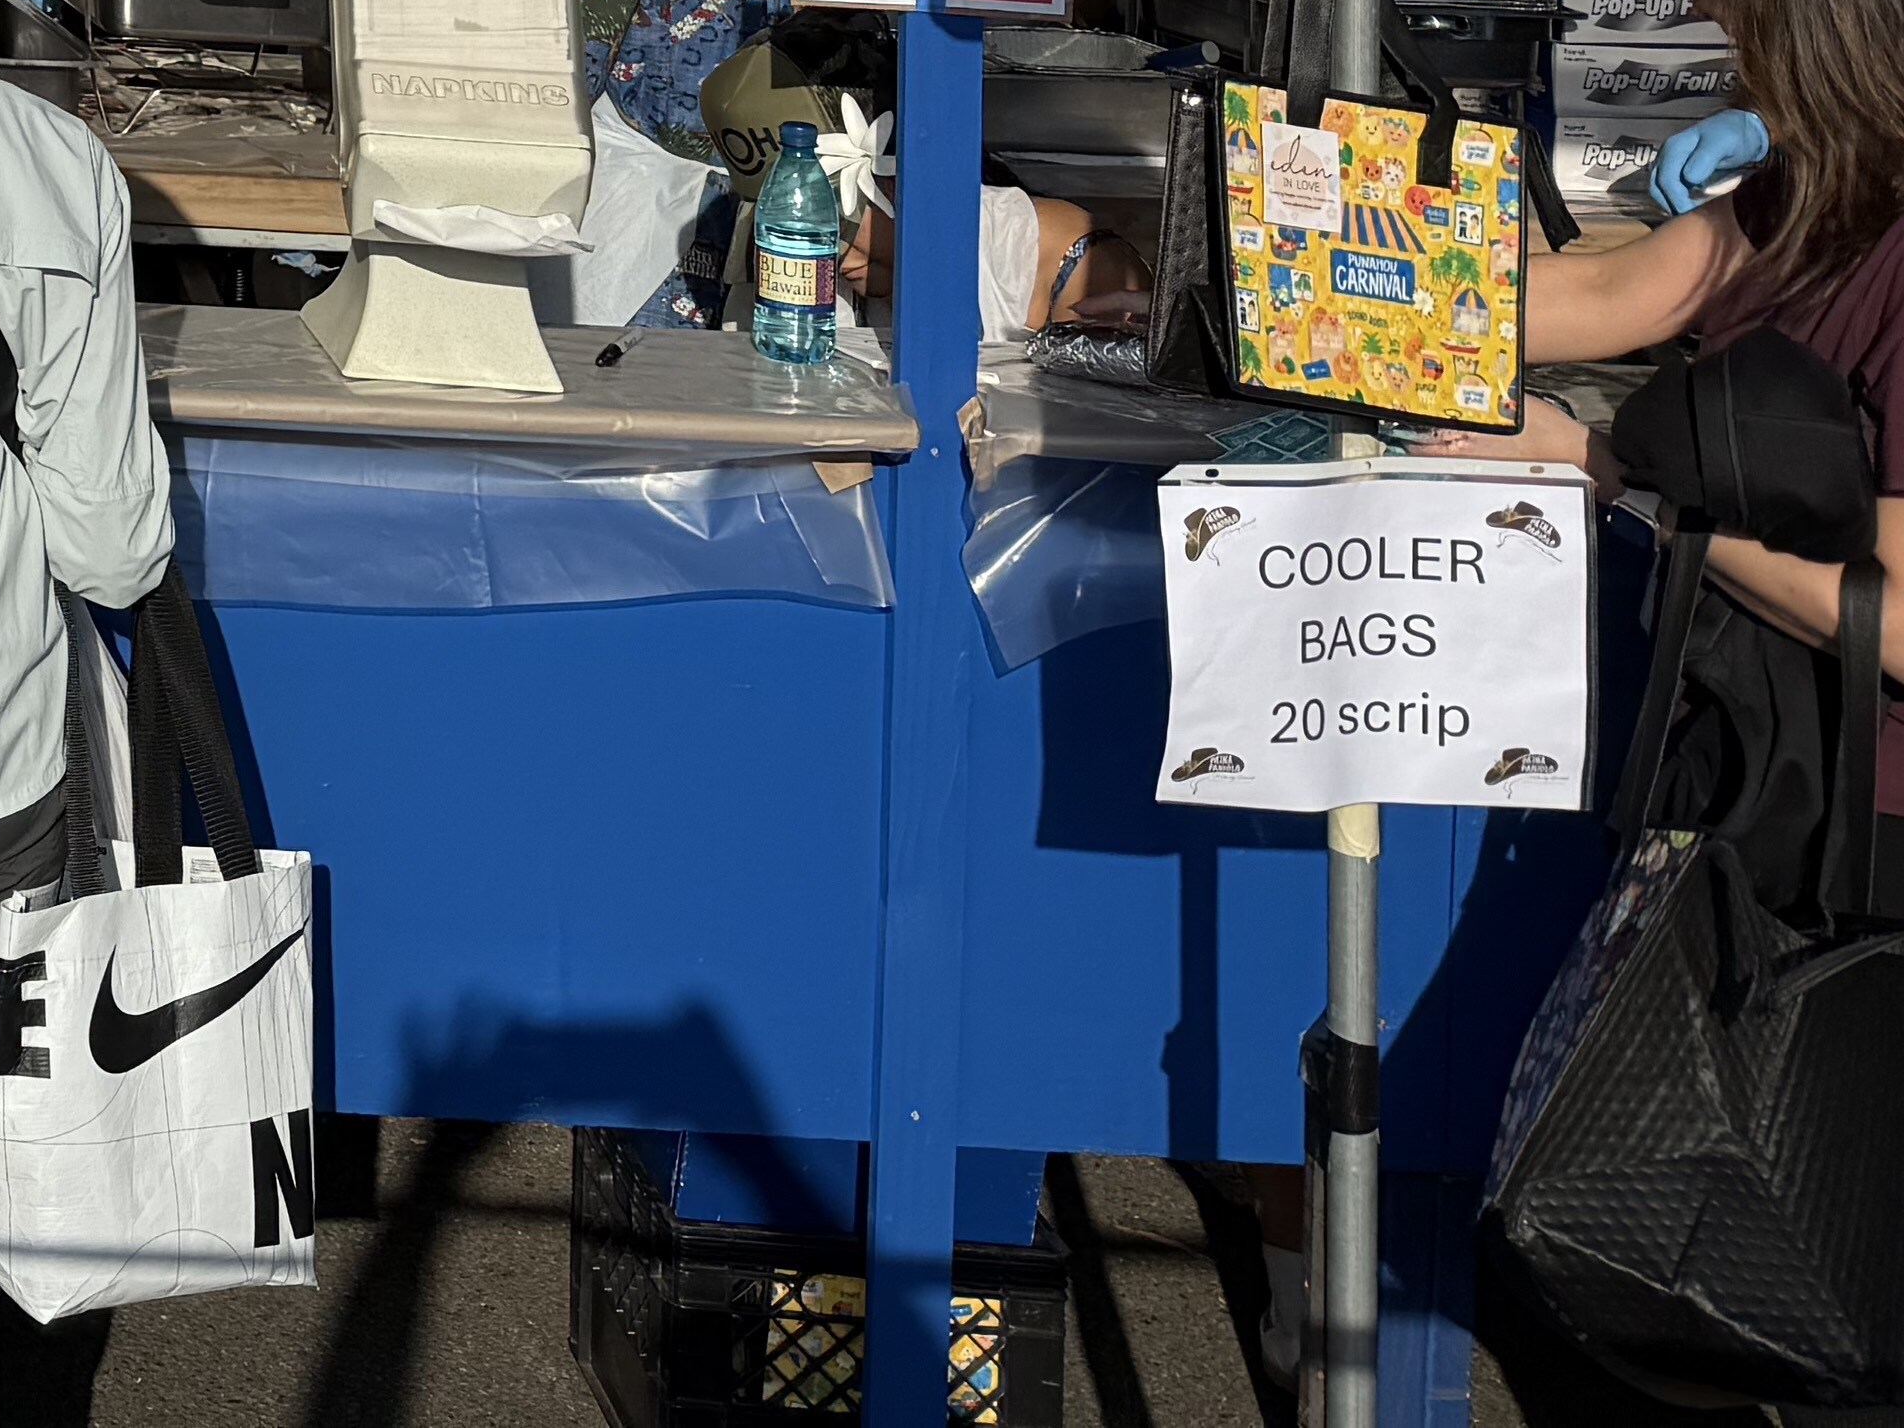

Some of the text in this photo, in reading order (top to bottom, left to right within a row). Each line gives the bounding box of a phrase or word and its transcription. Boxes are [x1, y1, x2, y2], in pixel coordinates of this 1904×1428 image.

[370, 72, 571, 108] NAPKINS
[1583, 67, 1671, 94] Pop-Up
[1674, 70, 1720, 91] Foil
[1270, 135, 1333, 179] eden
[1282, 178, 1321, 194] IN LOVE
[760, 252, 814, 280] BLUE
[1347, 253, 1398, 273] PUNAHOU
[759, 271, 814, 298] Hawaii
[1335, 266, 1412, 302] CARNIVAL
[1257, 535, 1486, 591] COOLER
[1300, 612, 1438, 665] BAGS
[1269, 691, 1471, 748] 20 scrip
[249, 1107, 315, 1249] N
